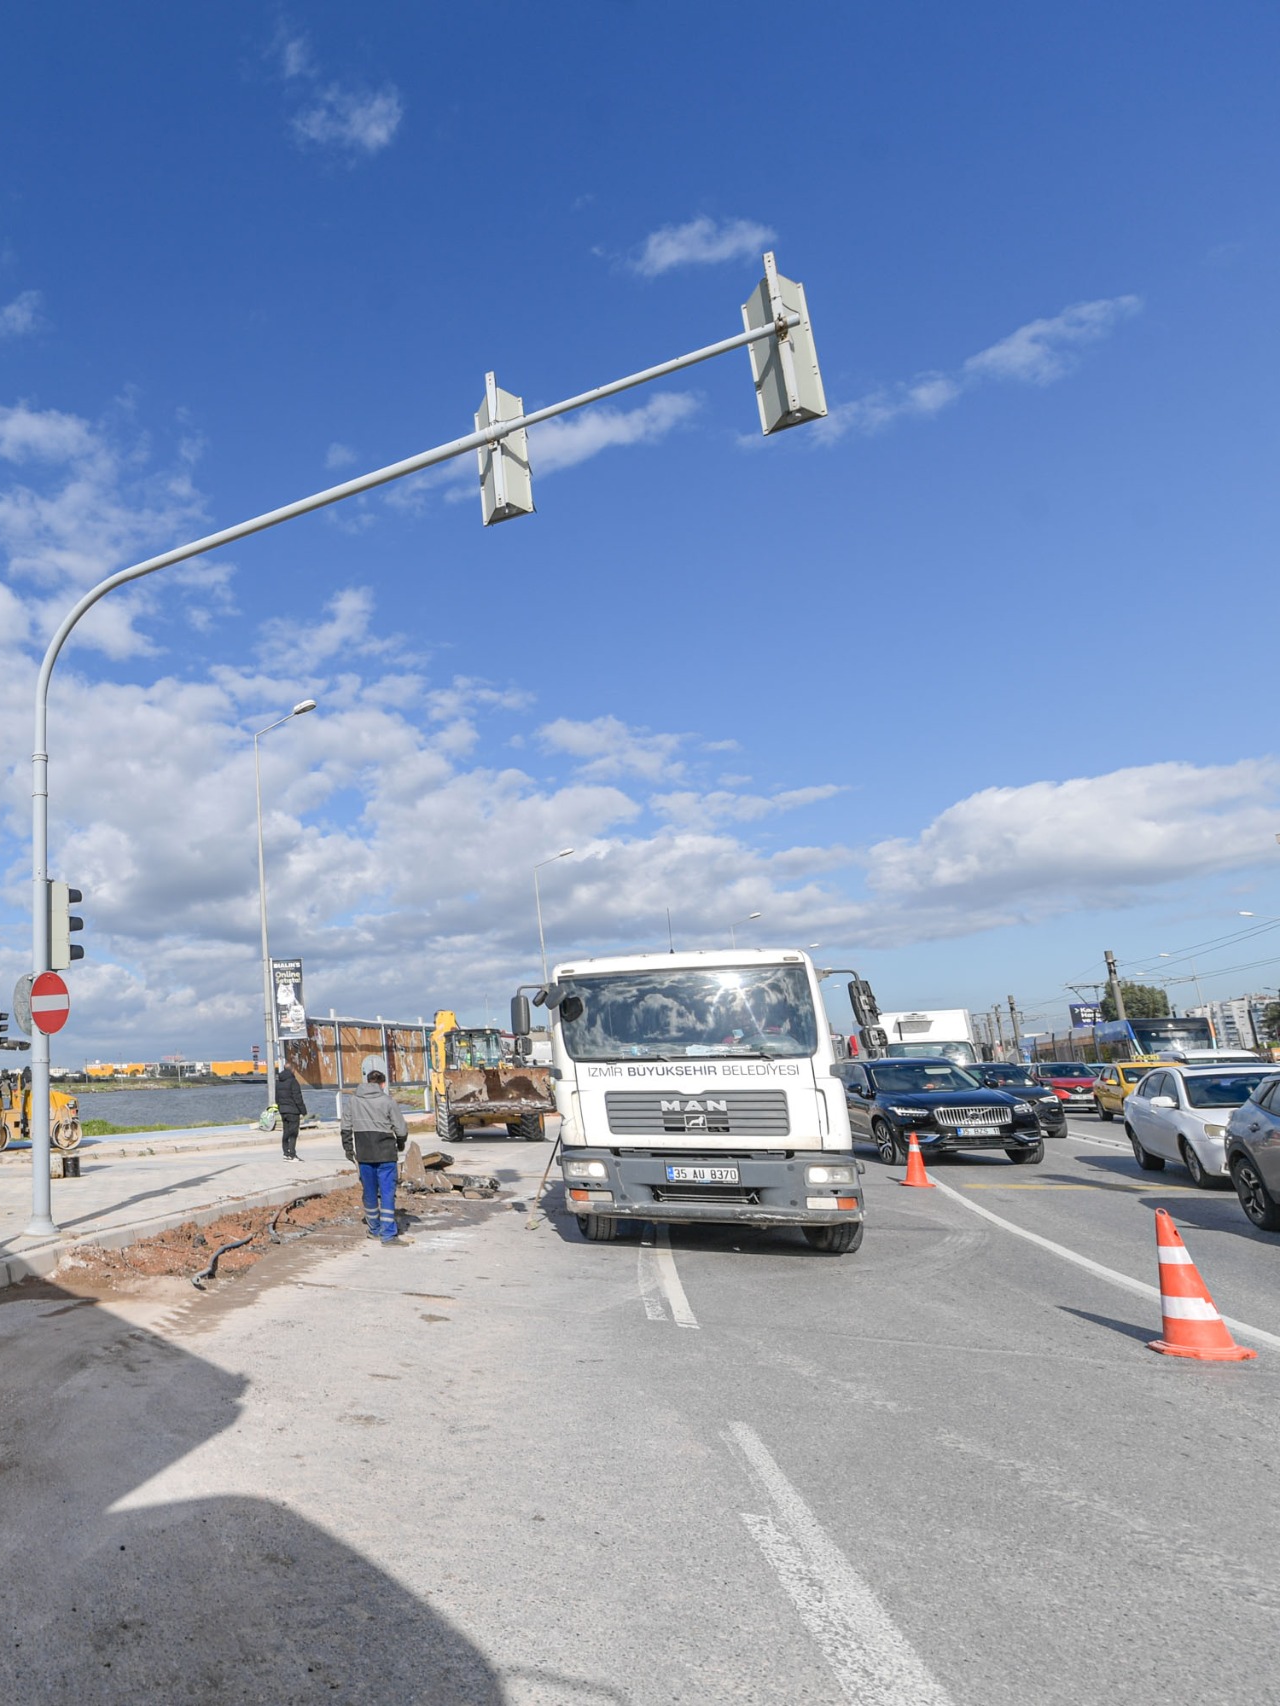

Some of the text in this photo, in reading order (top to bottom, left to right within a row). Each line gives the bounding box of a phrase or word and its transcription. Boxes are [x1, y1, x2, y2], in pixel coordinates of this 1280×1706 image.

[660, 1100, 728, 1112] MAN
[674, 1168, 737, 1180] 35 AU 8370
